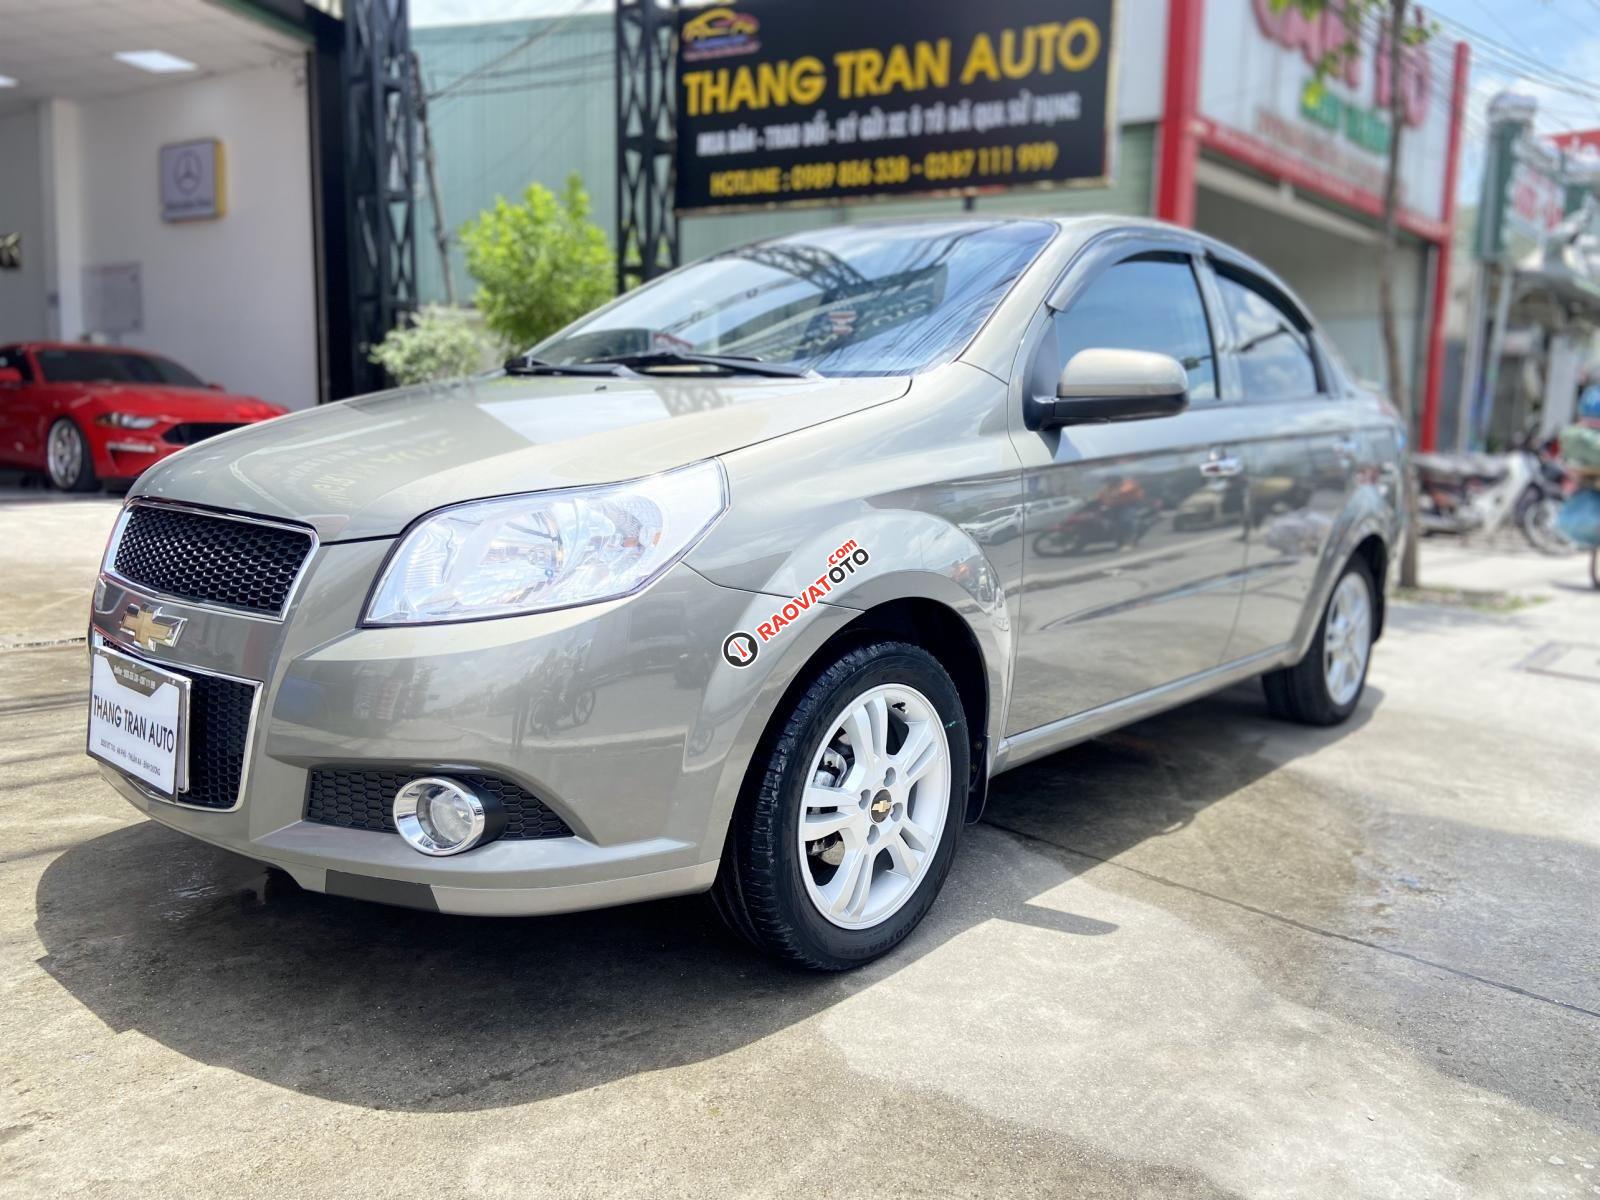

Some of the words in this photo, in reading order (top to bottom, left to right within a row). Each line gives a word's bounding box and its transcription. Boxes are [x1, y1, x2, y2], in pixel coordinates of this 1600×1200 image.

[682, 56, 827, 117] THANG
[835, 37, 951, 98] TRAN
[961, 16, 1101, 85] AUTO
[93, 694, 122, 728] THANG
[124, 709, 147, 741] TRAN
[148, 724, 174, 753] AUTO
